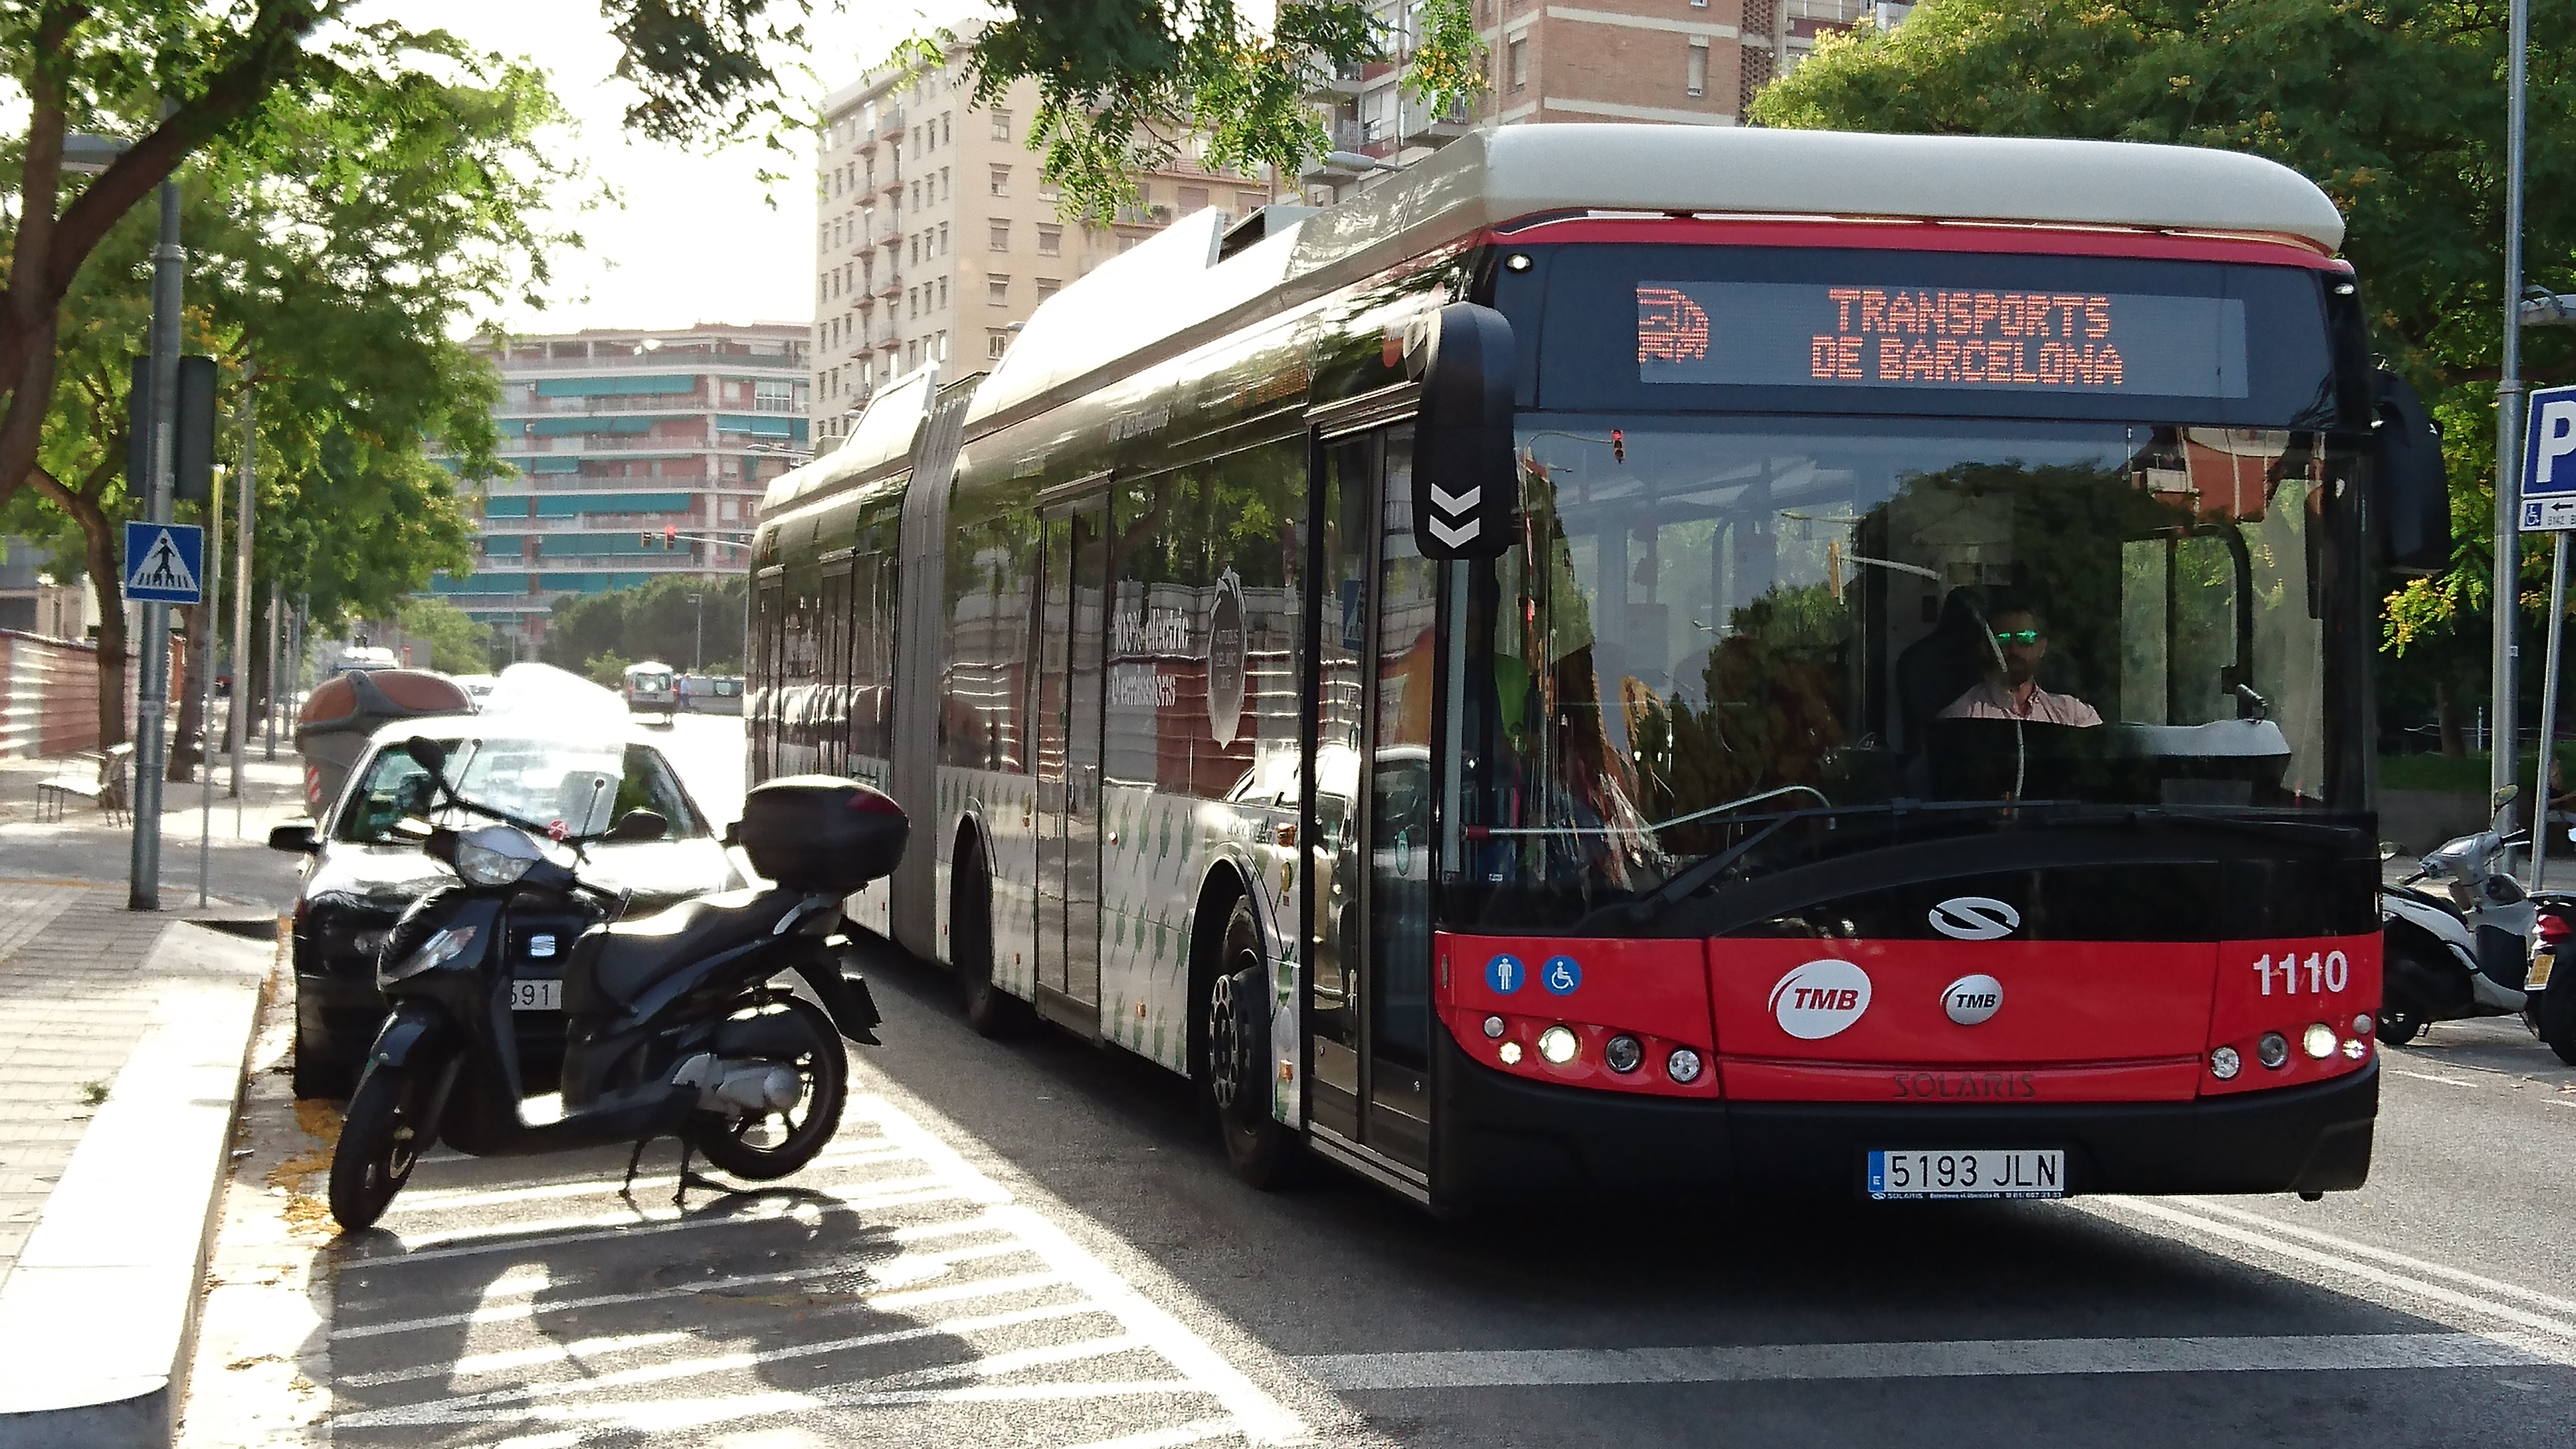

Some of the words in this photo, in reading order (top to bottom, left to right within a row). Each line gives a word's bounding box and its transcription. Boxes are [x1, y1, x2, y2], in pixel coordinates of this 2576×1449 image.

[1830, 288, 2111, 339] TRANSPORTS
[1812, 335, 1864, 380] DE
[1879, 339, 2124, 385] BARCELONA
[2536, 400, 2576, 483] P
[2253, 950, 2347, 996] 1110
[1795, 988, 1858, 1010] TMB
[1957, 994, 1996, 1009] TMB
[1894, 1074, 2036, 1098] SOLARIS
[1873, 1176, 1880, 1185] E
[1892, 1155, 1977, 1187] 5193
[1993, 1155, 2056, 1186] JLN
